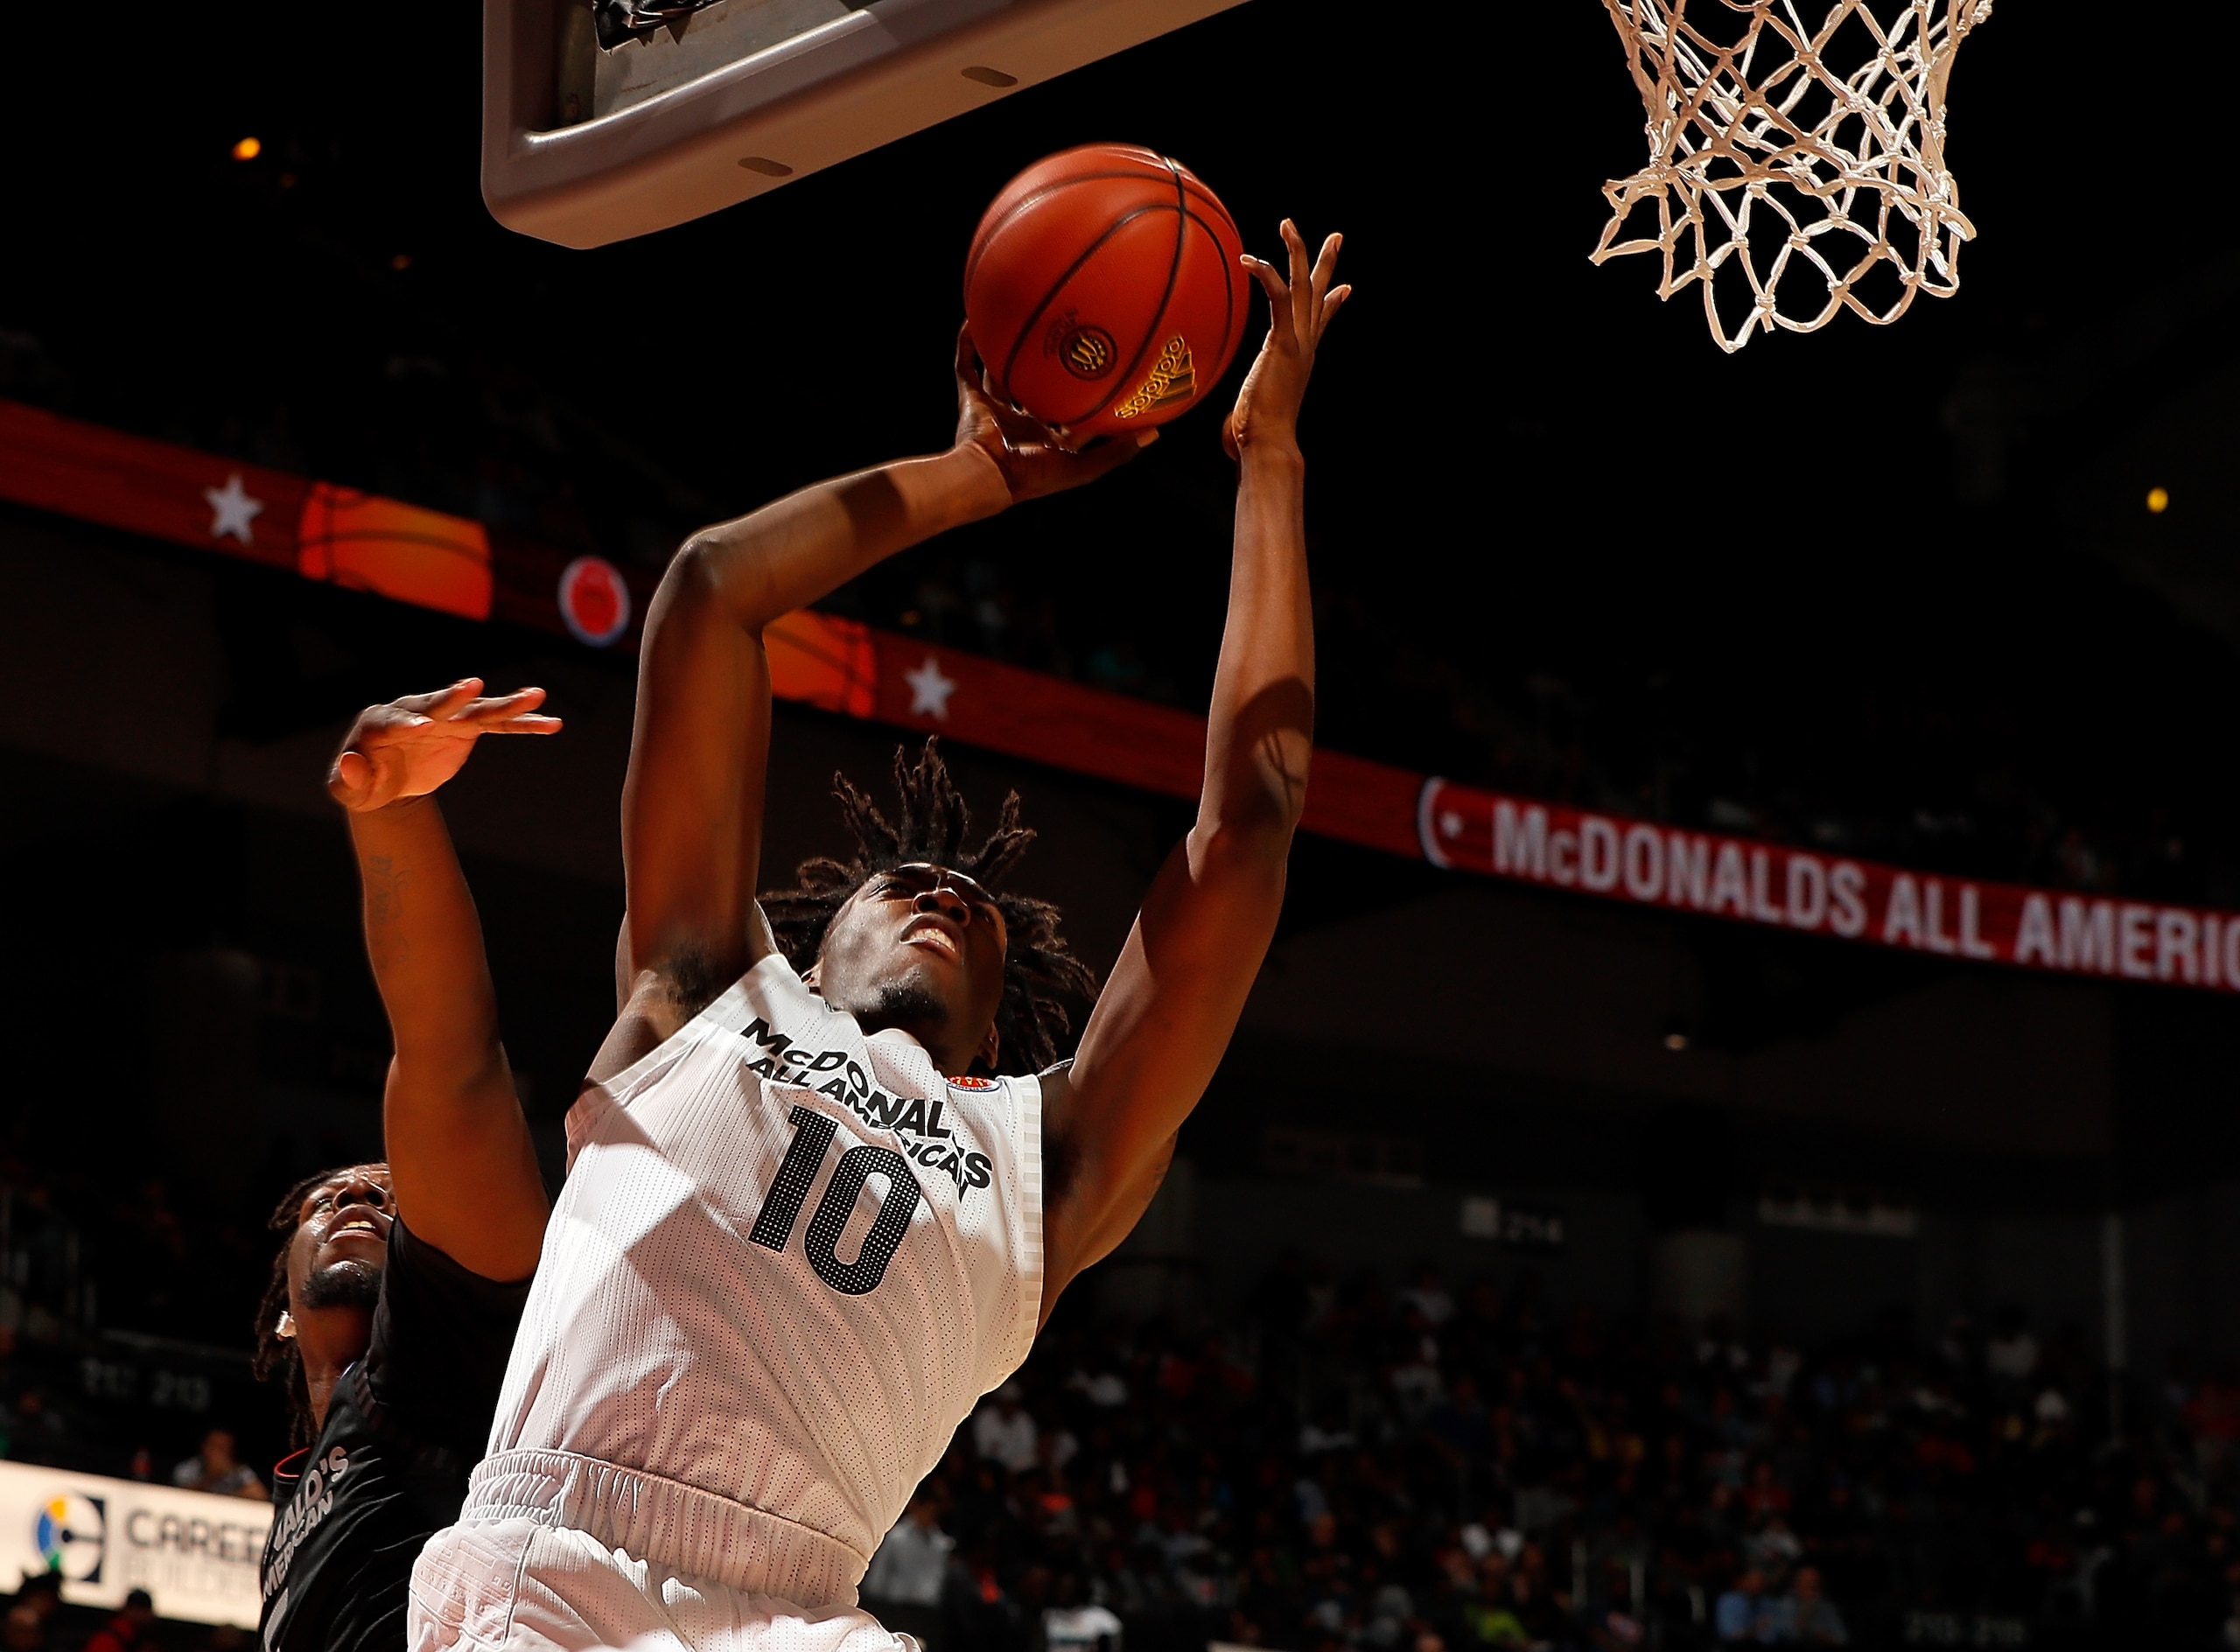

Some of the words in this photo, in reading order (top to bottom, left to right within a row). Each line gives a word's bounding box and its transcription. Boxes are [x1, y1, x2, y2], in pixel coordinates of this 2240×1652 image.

[1114, 336, 1186, 419] adidas
[1491, 797, 1870, 940] McDONALDS
[1881, 870, 1999, 962] ALL
[746, 1057, 810, 1087] ALL
[748, 1104, 921, 1296] 10
[127, 1508, 266, 1563] CAREE
